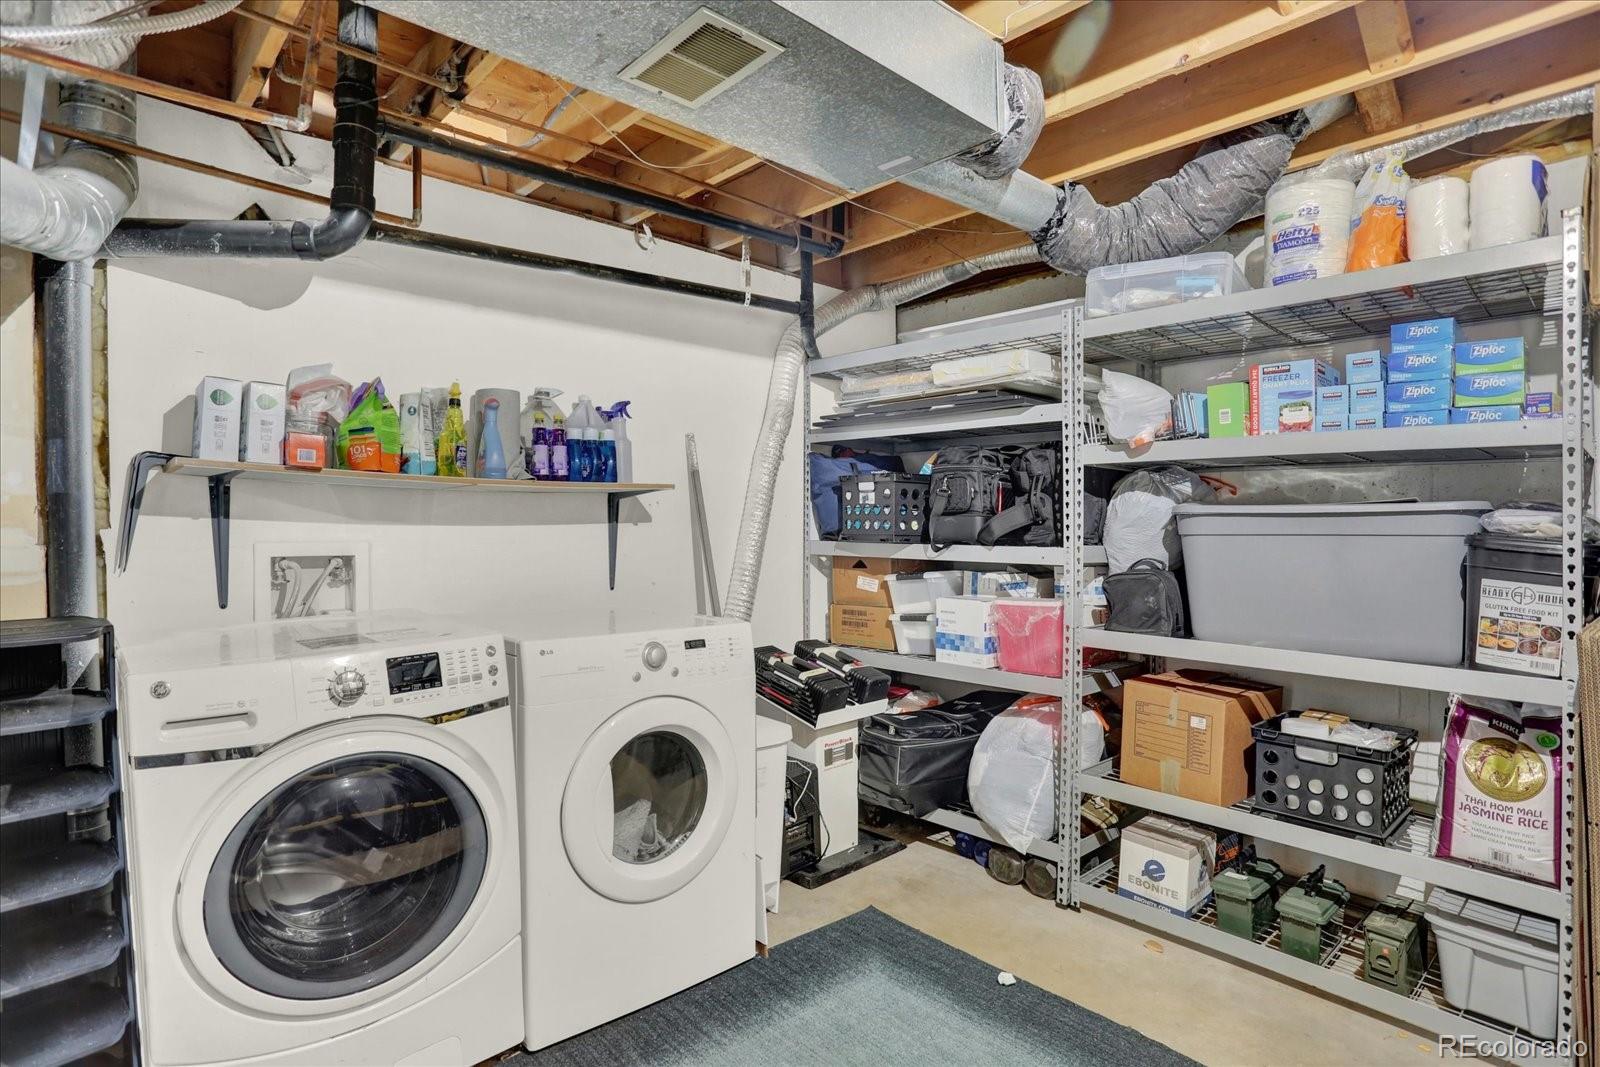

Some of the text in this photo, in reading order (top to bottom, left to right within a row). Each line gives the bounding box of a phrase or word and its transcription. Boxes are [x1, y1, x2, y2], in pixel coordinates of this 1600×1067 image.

[1278, 228, 1313, 241] Hefty
[1409, 325, 1440, 338] Ziploc
[1474, 344, 1506, 358] Ziploc
[1406, 356, 1438, 368] Ziploc
[1263, 373, 1301, 383] FREEZER
[1472, 377, 1506, 390] Ziploc
[1404, 386, 1436, 399] Ziploc
[1402, 416, 1434, 427] Ziploc
[1468, 411, 1502, 424] Ziploc
[350, 445, 366, 456] 101
[1485, 603, 1509, 611] GLUTEN
[1528, 609, 1546, 617] FOOD
[1464, 794, 1542, 818] THAI HOM MALI
[1459, 801, 1549, 830] JASMINE RICE
[1128, 874, 1179, 900] EBONITE
